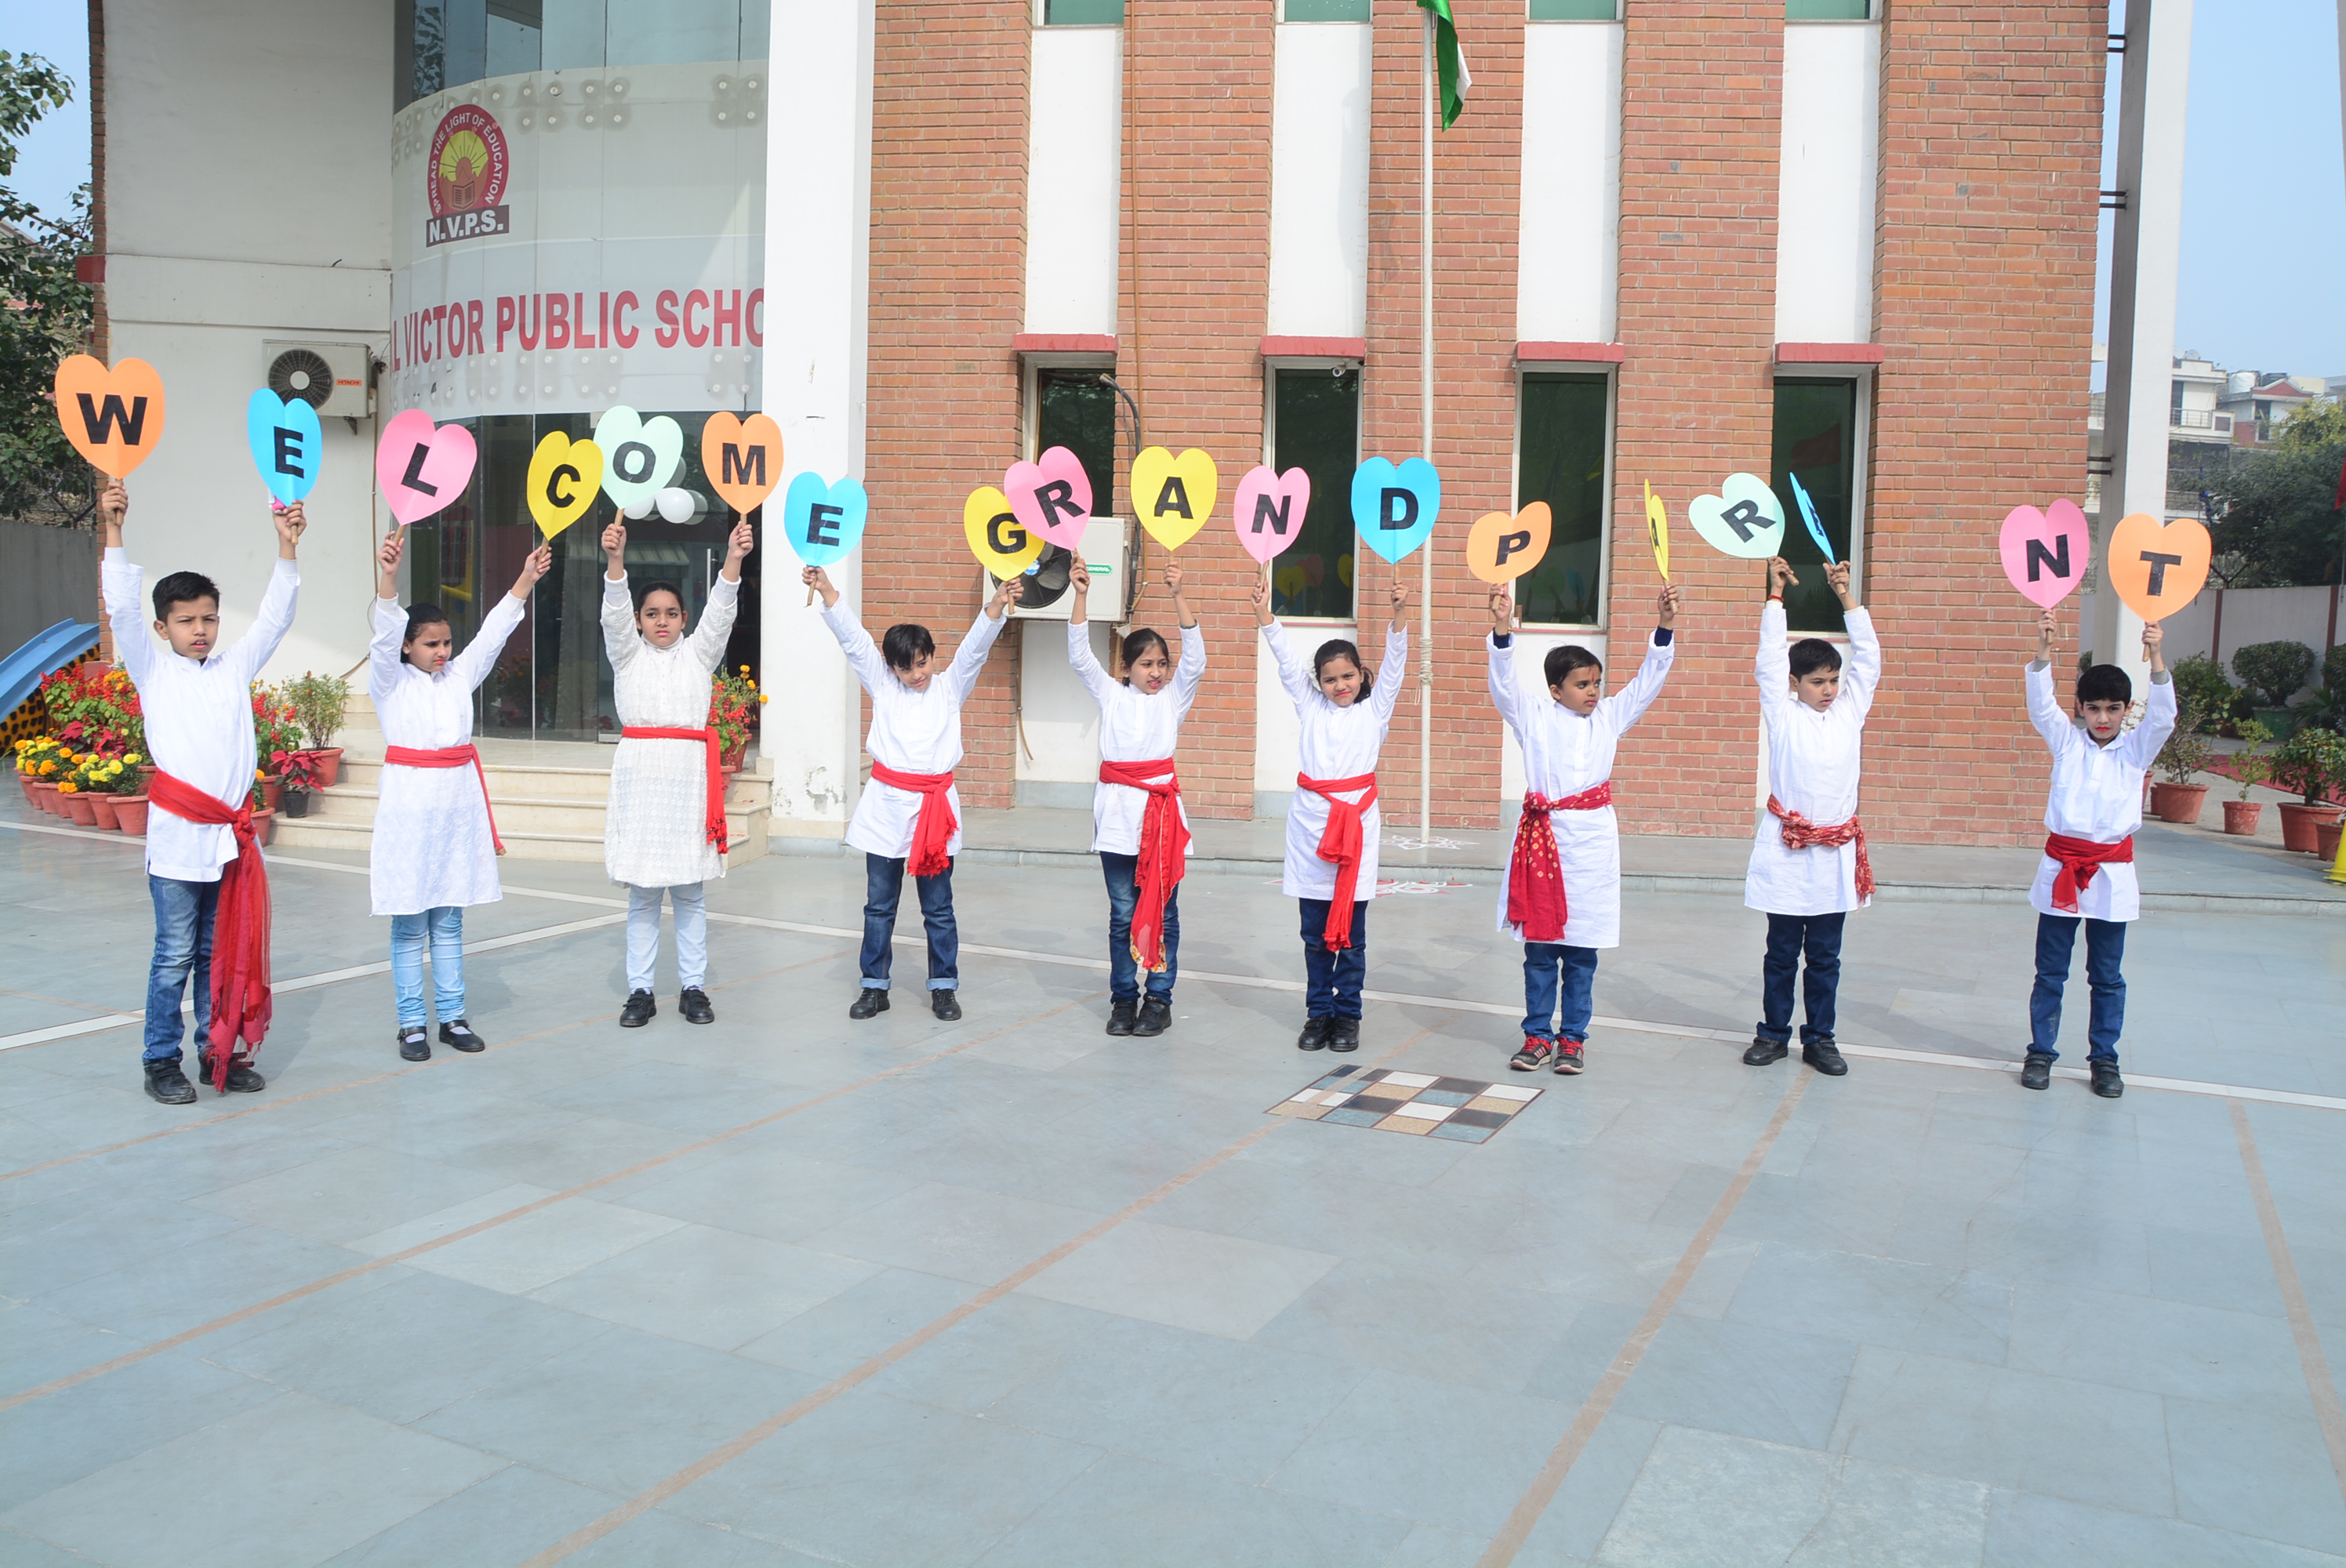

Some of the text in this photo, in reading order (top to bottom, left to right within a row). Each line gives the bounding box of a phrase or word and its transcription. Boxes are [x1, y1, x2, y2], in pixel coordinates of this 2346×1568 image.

[430, 113, 503, 213] SPREAD THE LIGHT OF EDUCATION
[429, 210, 504, 243] N.V.P.S.
[404, 299, 485, 367] VICTOR
[496, 290, 640, 353] PUBLIC
[78, 394, 147, 445] W
[274, 426, 304, 478] E
[401, 442, 438, 496] L
[612, 441, 656, 484] O
[723, 443, 765, 485] M
[547, 464, 581, 508] C
[1033, 479, 1086, 528] R
[1154, 477, 1193, 519] A
[806, 503, 844, 546] E
[1252, 494, 1291, 535] N
[1380, 487, 1418, 530] D
[1720, 499, 1776, 543] R
[986, 513, 1027, 554] G
[1495, 531, 1531, 566] P
[2025, 534, 2070, 583] N
[2140, 550, 2182, 596] T
